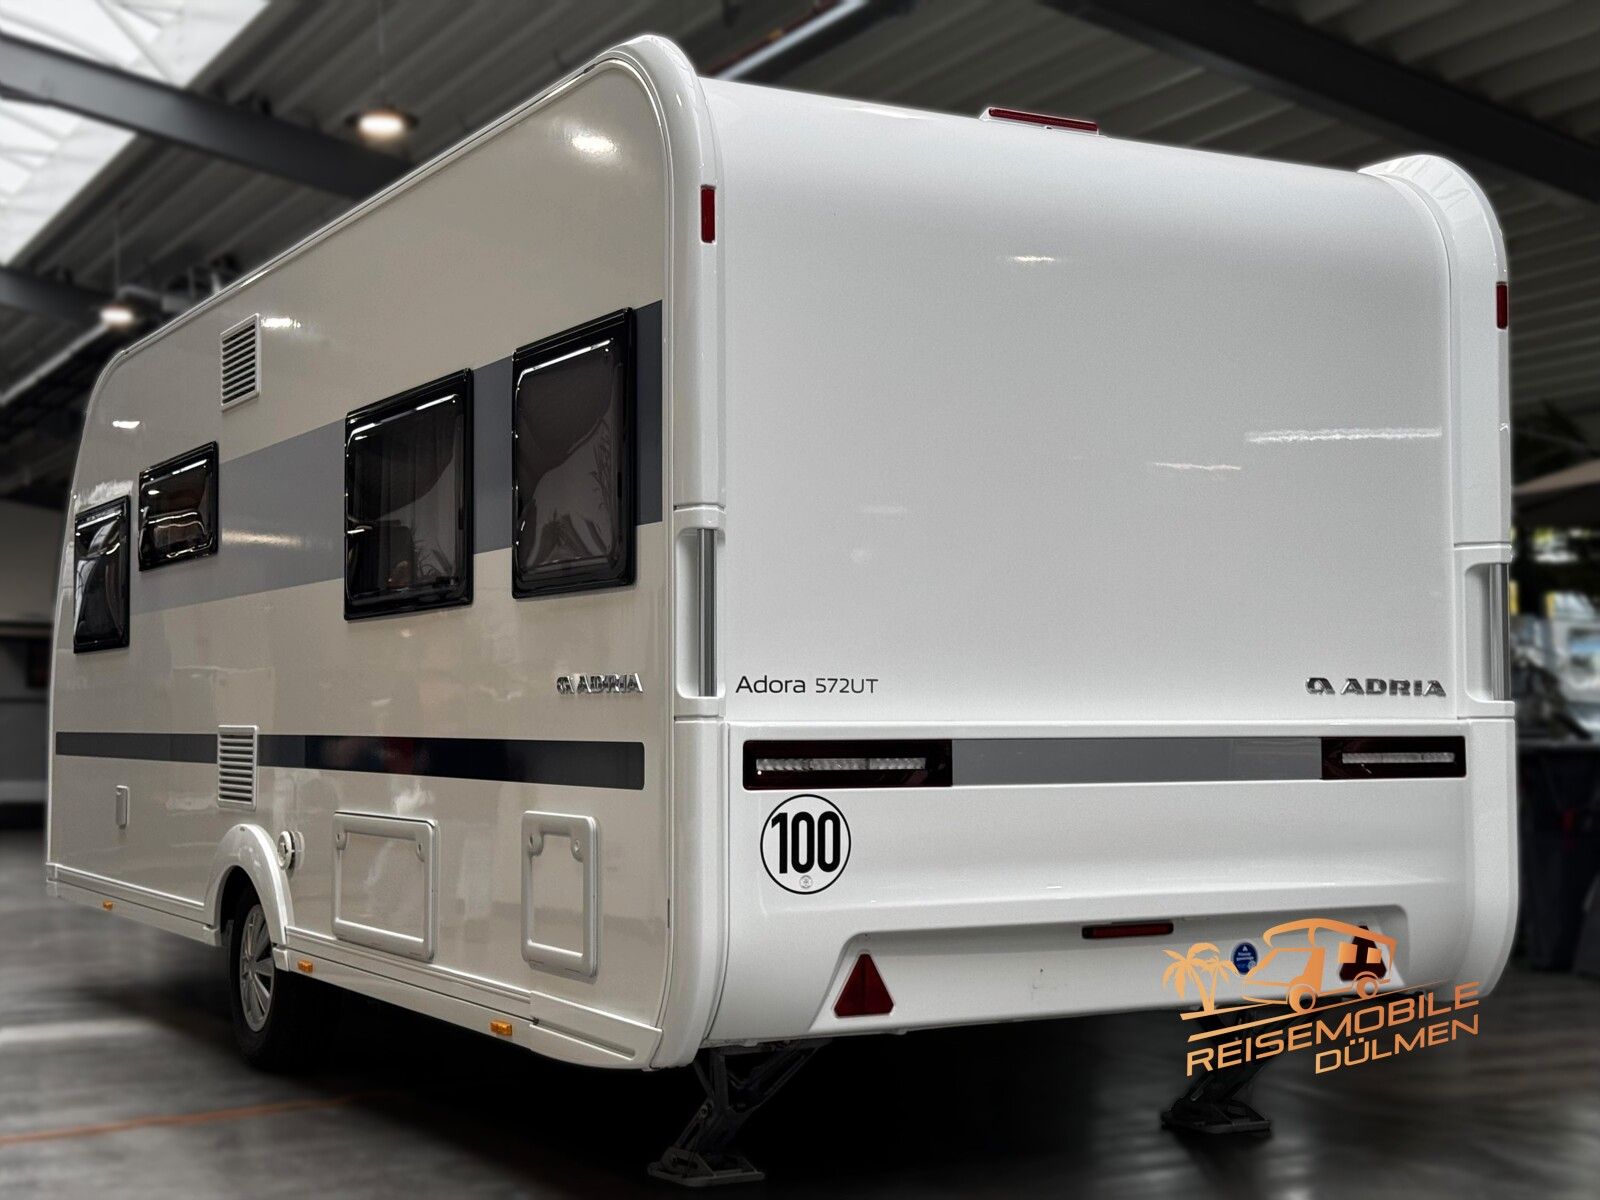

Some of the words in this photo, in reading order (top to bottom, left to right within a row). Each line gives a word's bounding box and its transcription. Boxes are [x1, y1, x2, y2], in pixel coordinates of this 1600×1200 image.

[577, 673, 643, 694] ADRIA
[735, 675, 806, 694] Adora
[815, 677, 879, 694] 572UT
[1341, 677, 1447, 697] ADRIA
[771, 810, 841, 874] 100
